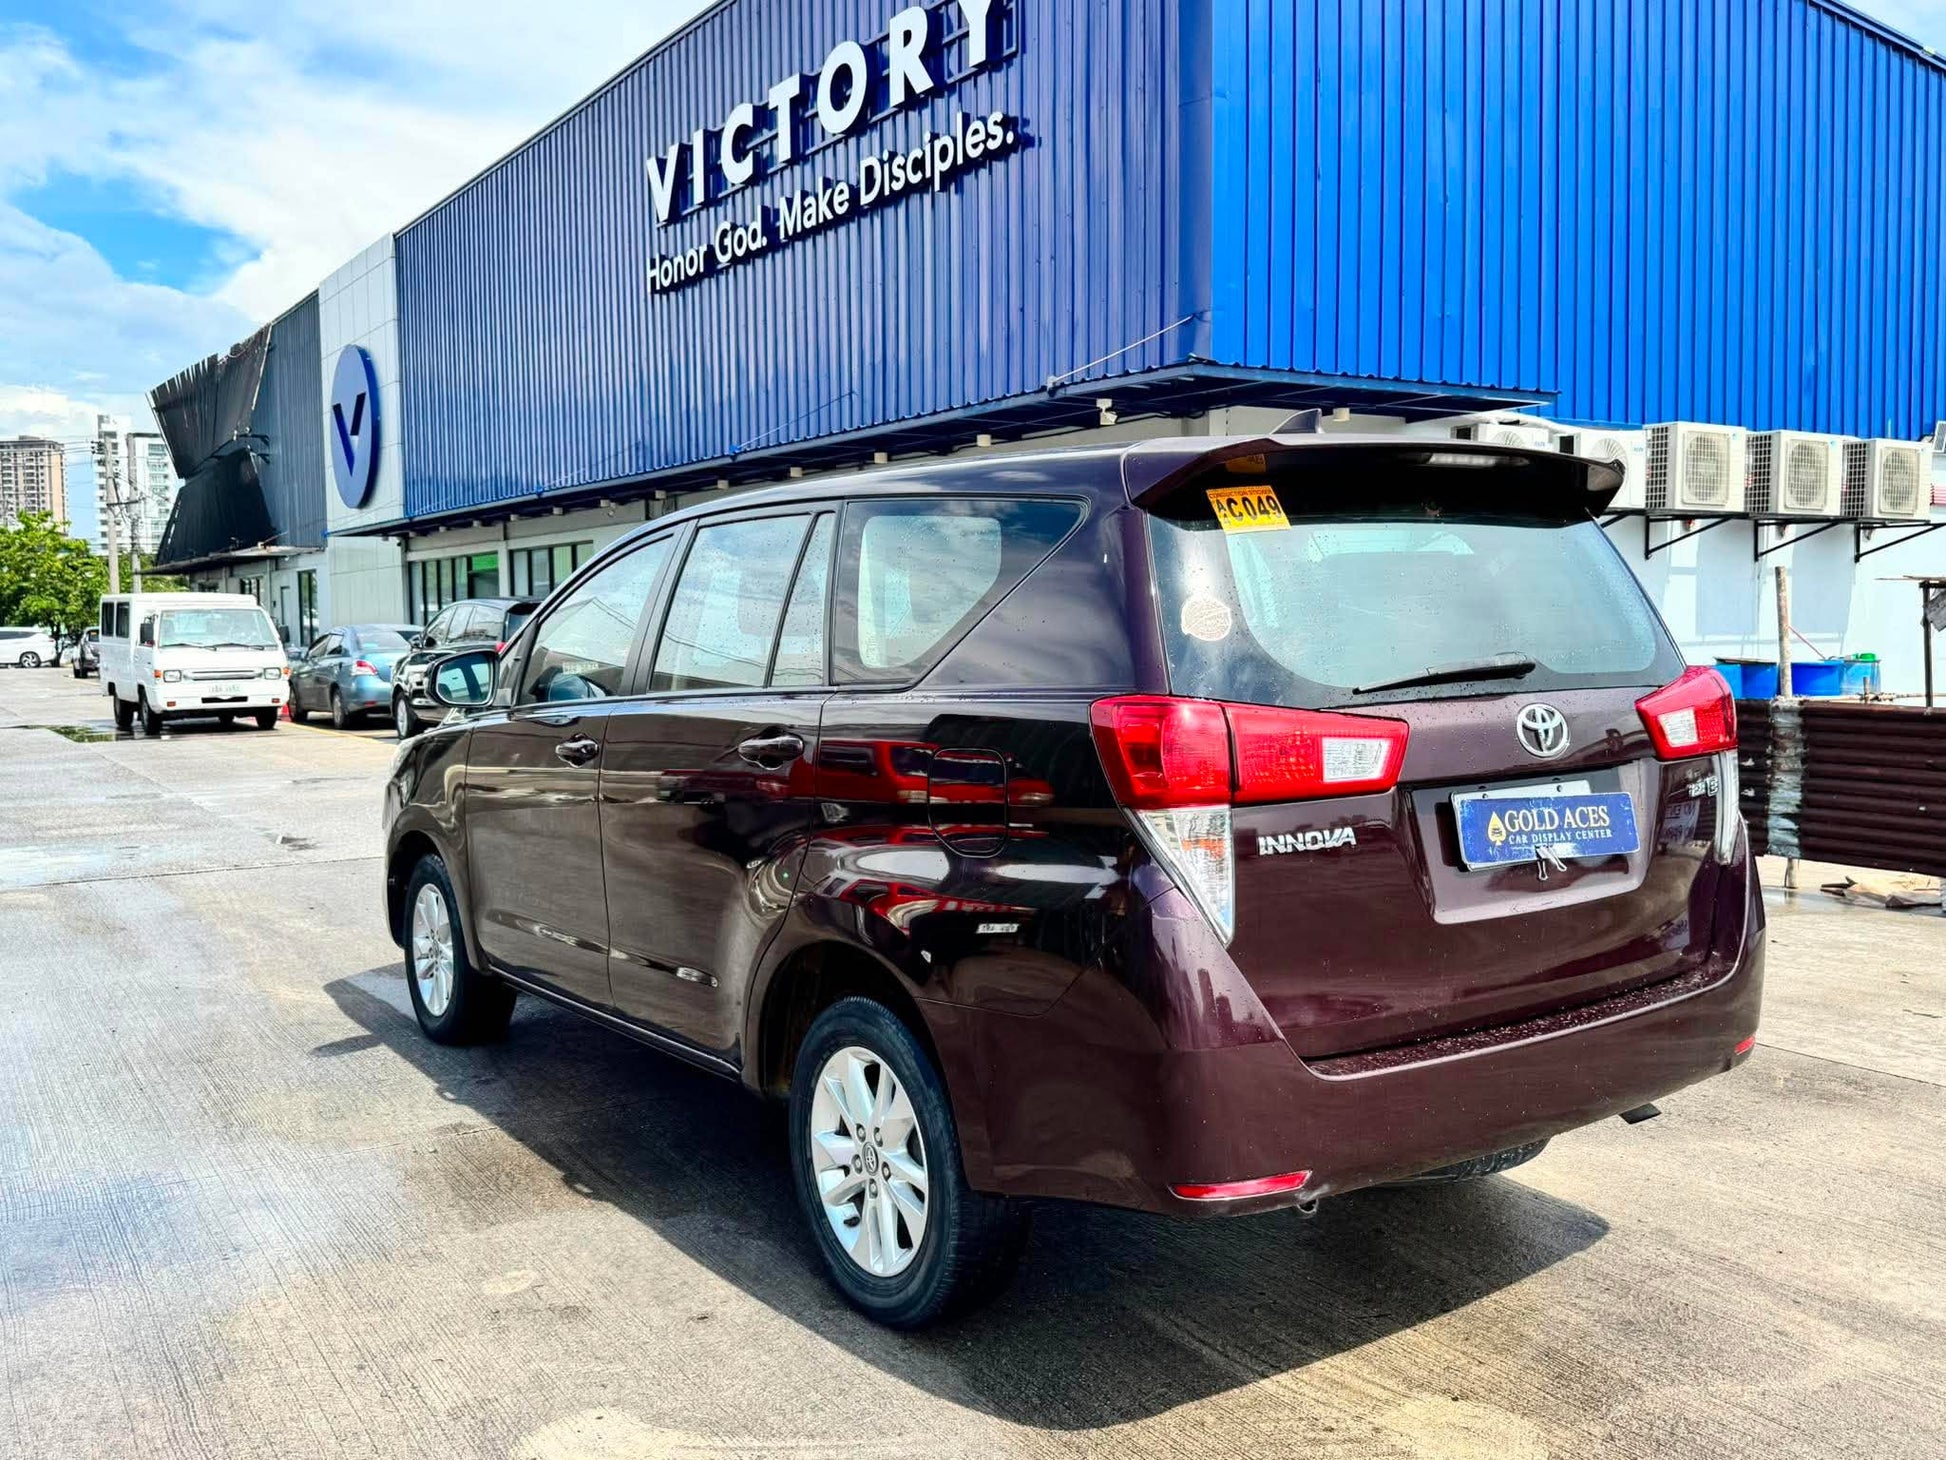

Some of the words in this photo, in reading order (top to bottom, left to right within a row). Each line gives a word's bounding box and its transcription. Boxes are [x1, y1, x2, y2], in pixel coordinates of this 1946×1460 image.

[646, 0, 993, 224] VICTORY
[646, 243, 708, 292] Honor
[714, 205, 767, 265] God.
[779, 176, 850, 241] Make
[859, 110, 1015, 205] Disciples.
[1504, 808, 1559, 832] GOLD
[1564, 805, 1610, 829] ACES
[1258, 826, 1357, 856] INNOVA
[1508, 834, 1529, 845] CAR
[1532, 831, 1572, 843] DISPLAY
[1575, 829, 1613, 840] CENTER
